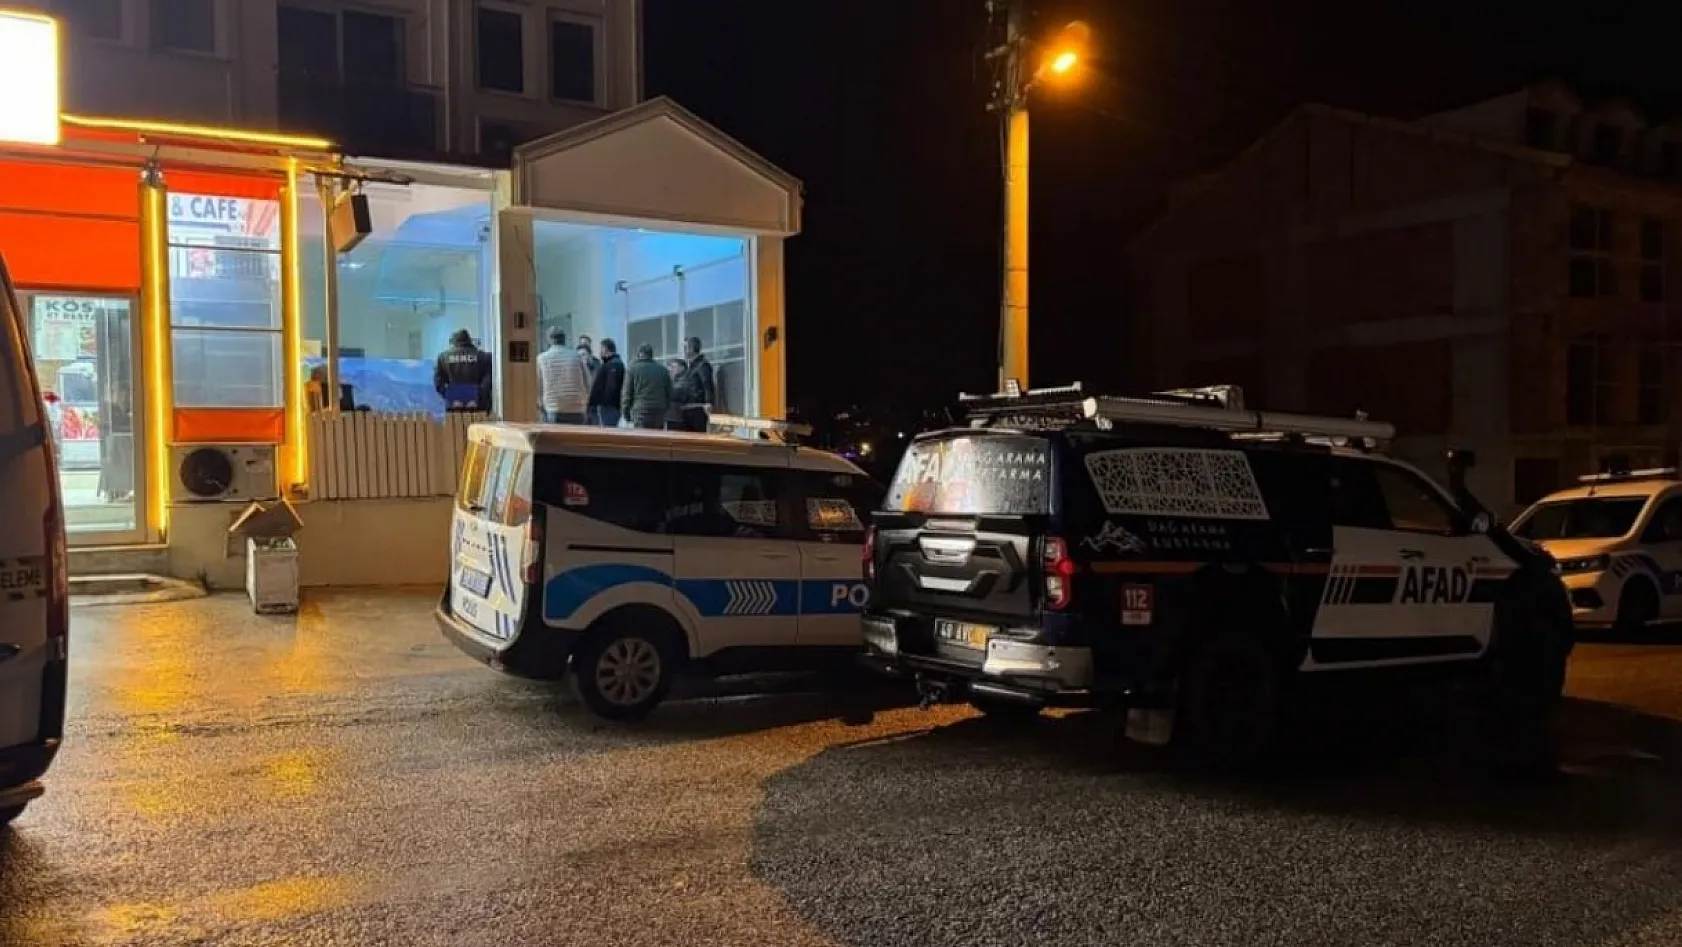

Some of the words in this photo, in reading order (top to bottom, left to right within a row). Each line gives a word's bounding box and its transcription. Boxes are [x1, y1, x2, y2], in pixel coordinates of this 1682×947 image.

[172, 196, 183, 217] &
[190, 197, 238, 219] CAFE
[1401, 566, 1467, 603] AFAD
[1126, 588, 1148, 609] 112
